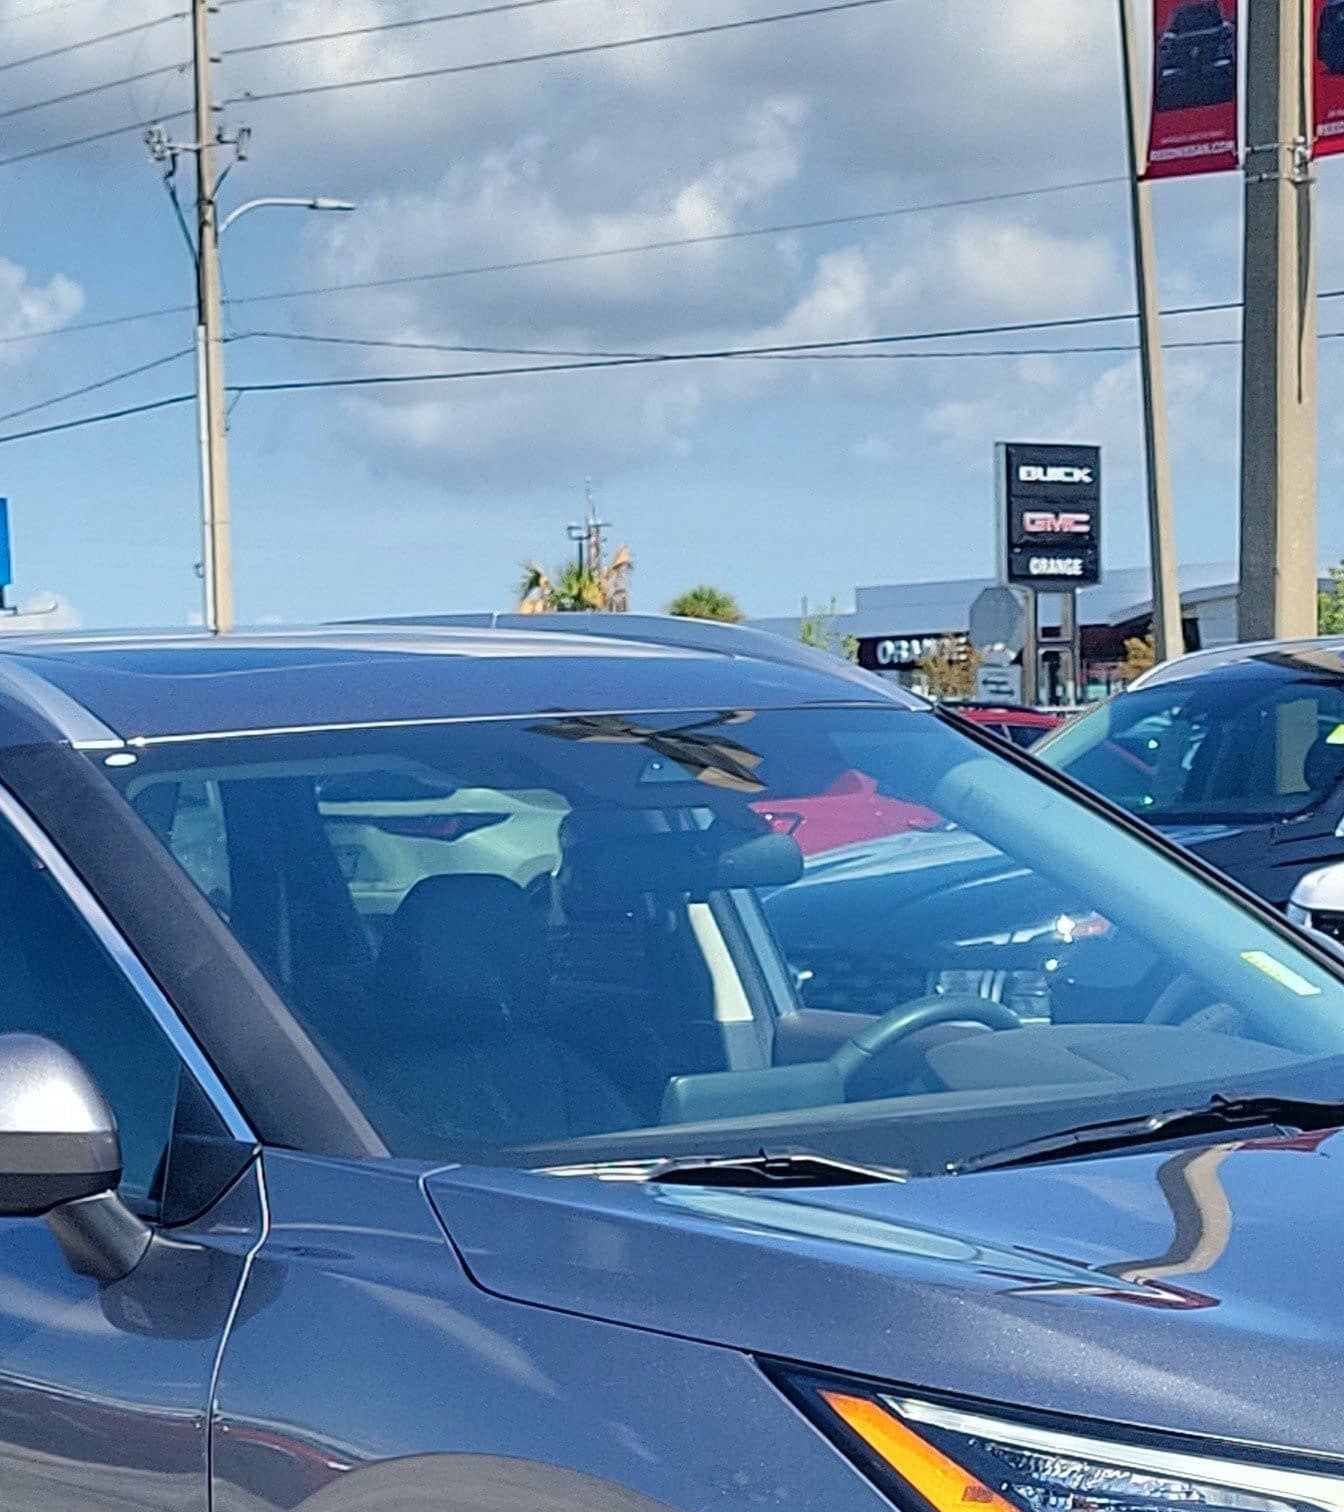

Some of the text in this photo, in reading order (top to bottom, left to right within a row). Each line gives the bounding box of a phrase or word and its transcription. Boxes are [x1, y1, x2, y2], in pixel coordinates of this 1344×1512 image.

[1019, 466, 1093, 483] BUICK
[1023, 511, 1090, 532] GMC
[1029, 557, 1083, 575] ORANGE
